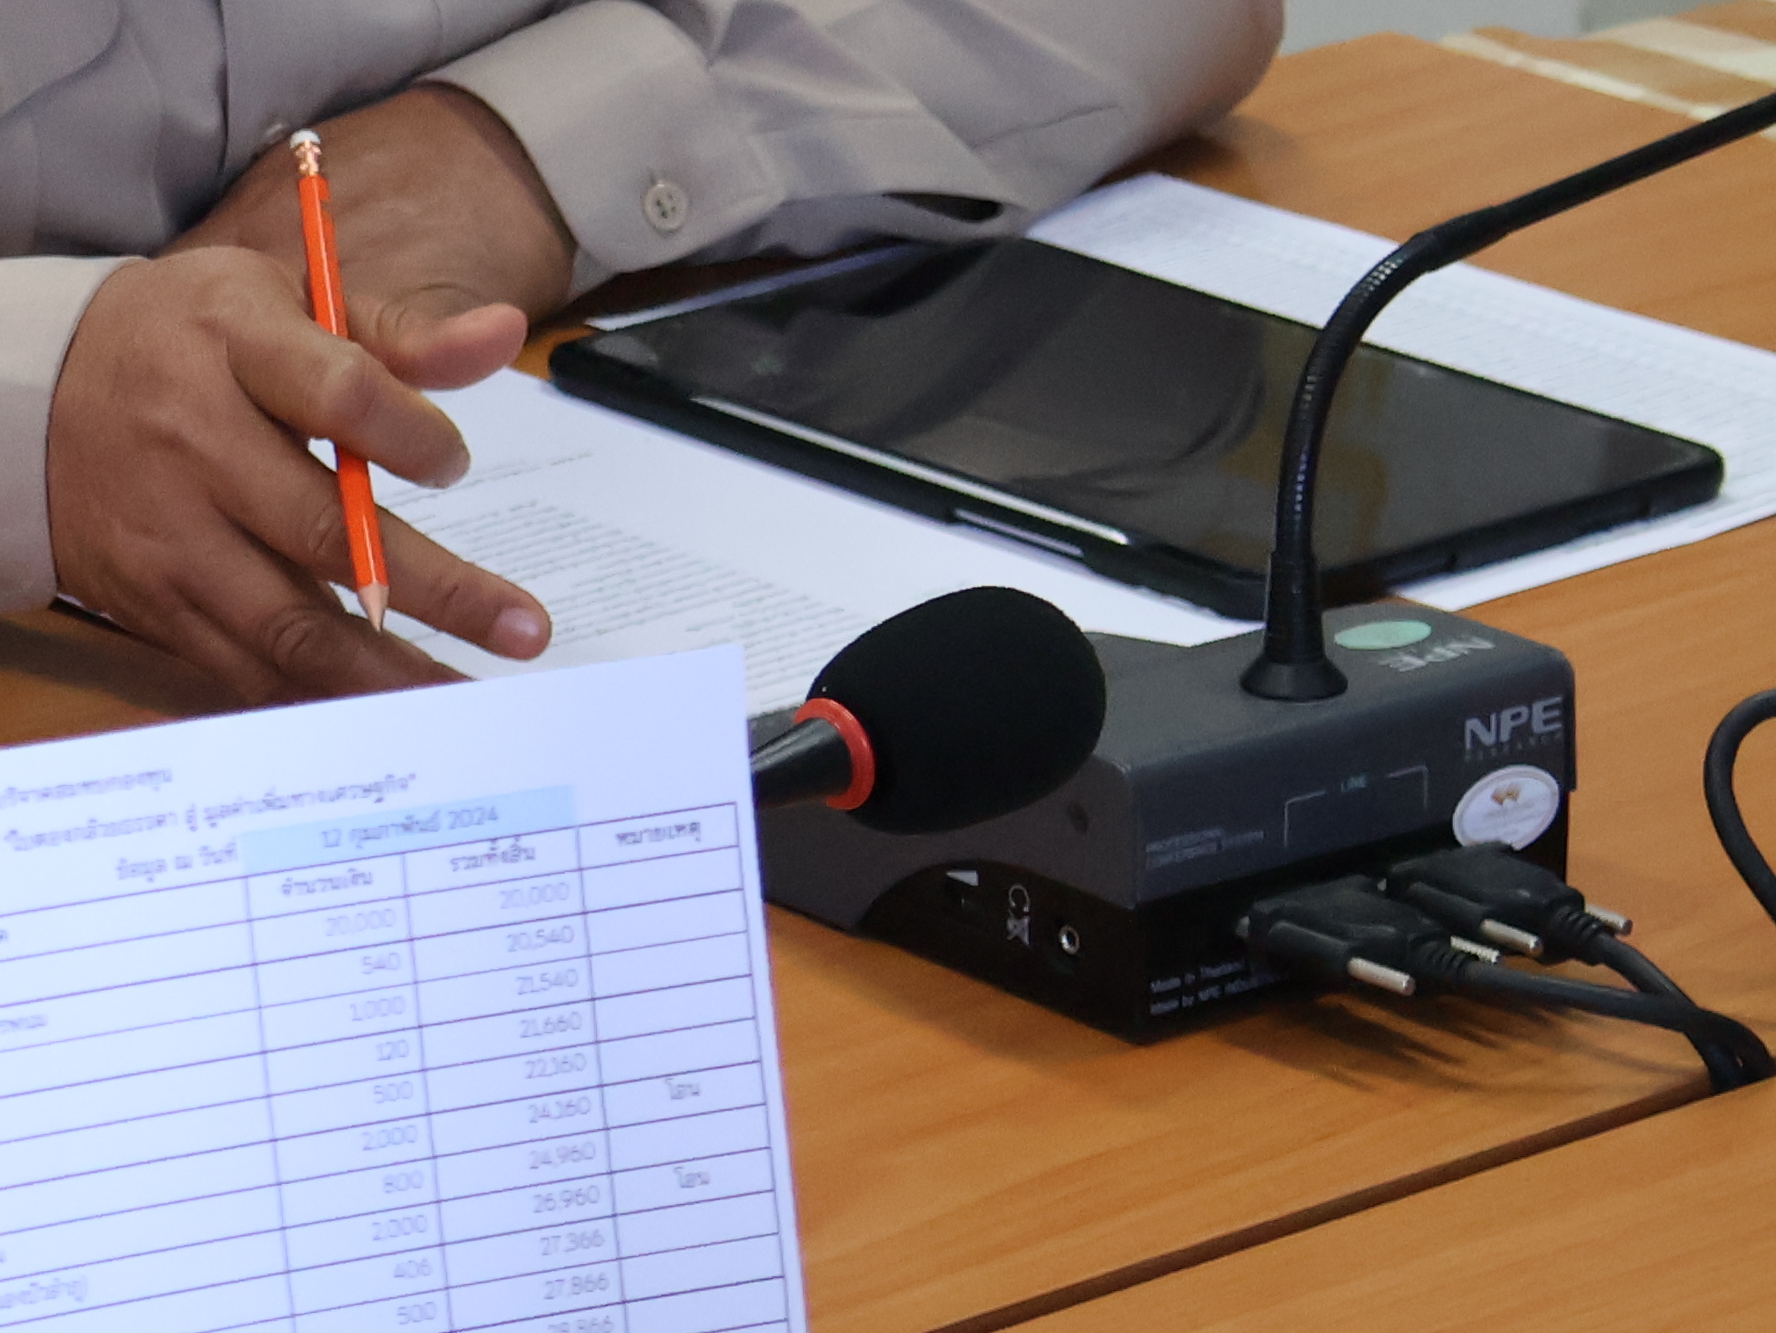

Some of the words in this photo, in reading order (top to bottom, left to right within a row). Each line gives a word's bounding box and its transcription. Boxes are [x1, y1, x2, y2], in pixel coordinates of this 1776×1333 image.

[1464, 696, 1563, 751] NPE
[321, 828, 341, 849] 12
[447, 804, 500, 831] 2024
[614, 818, 702, 849] หมายเหตุ
[448, 841, 537, 874] รวมทั้งสิ้น
[281, 868, 375, 898] จำนวนเงิน
